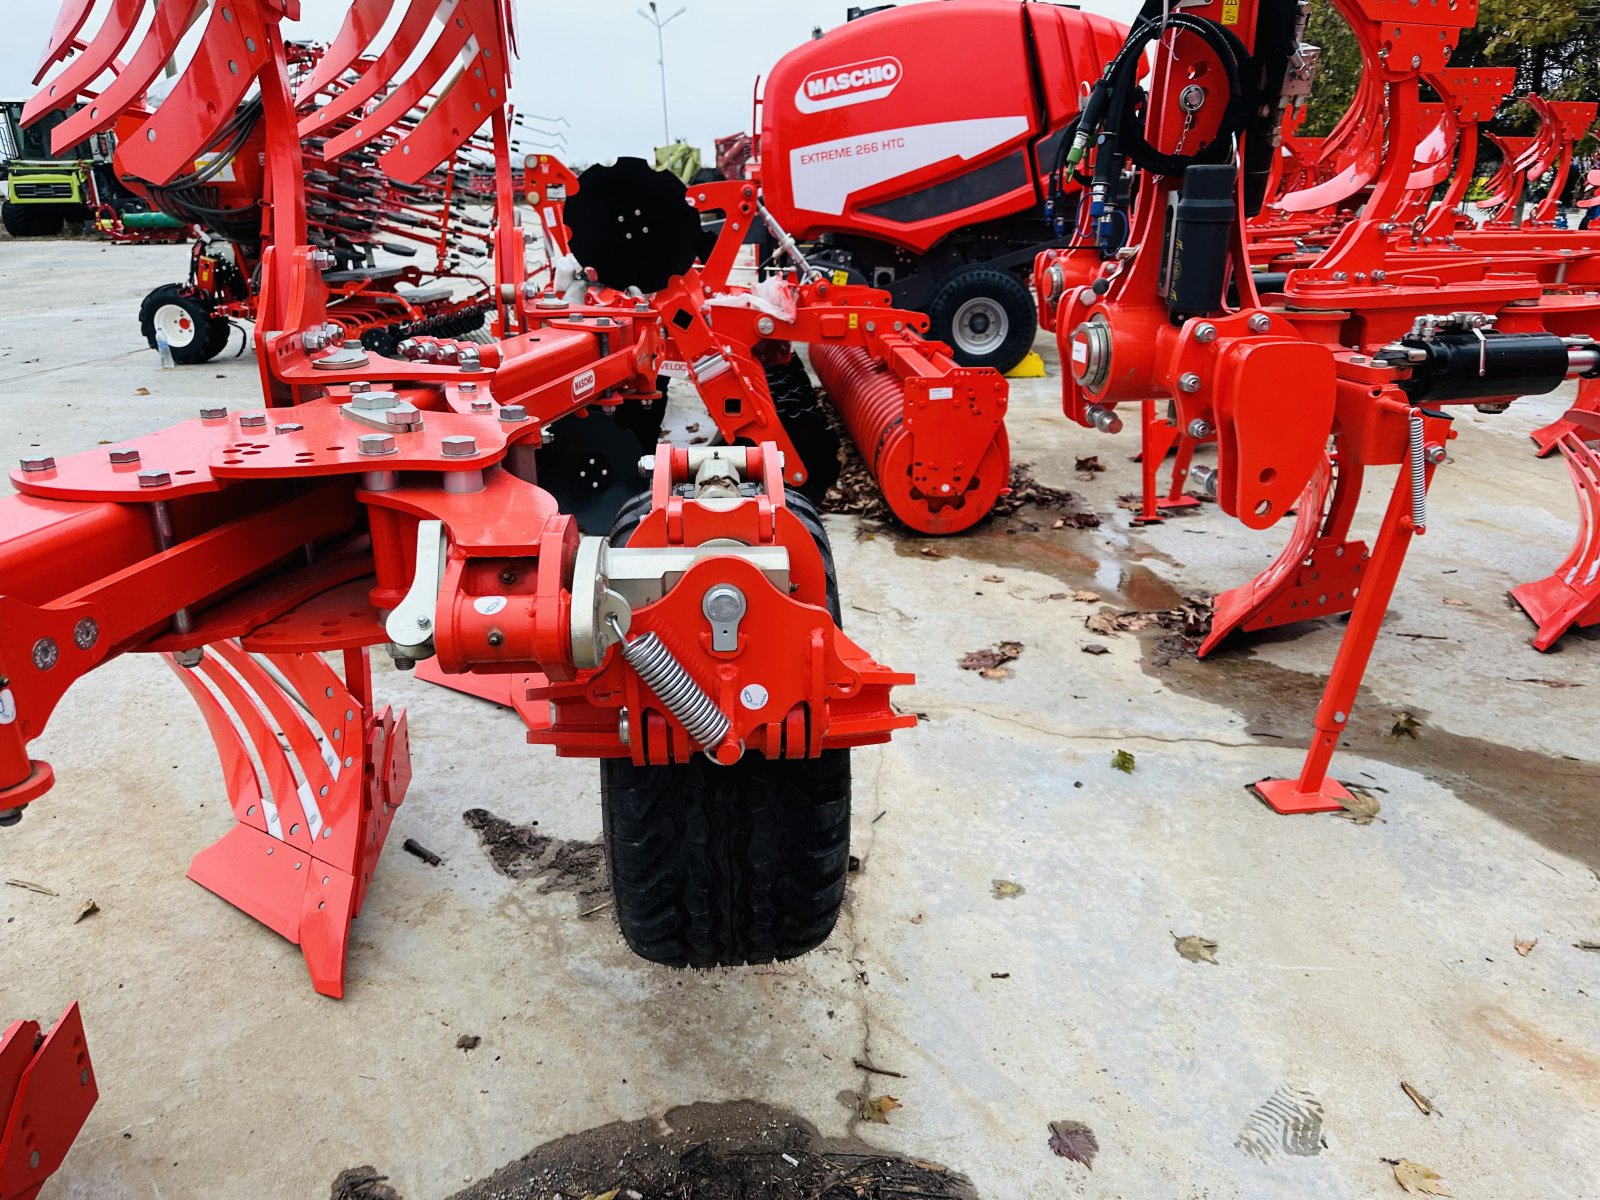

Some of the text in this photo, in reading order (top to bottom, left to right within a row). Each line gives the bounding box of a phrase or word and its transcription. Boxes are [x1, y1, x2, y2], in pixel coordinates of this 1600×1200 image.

[807, 63, 897, 97] MASCHIO
[801, 138, 905, 165] EXTREME 266 HTC
[661, 363, 686, 372] VELOC
[575, 375, 593, 391] MASCHIO
